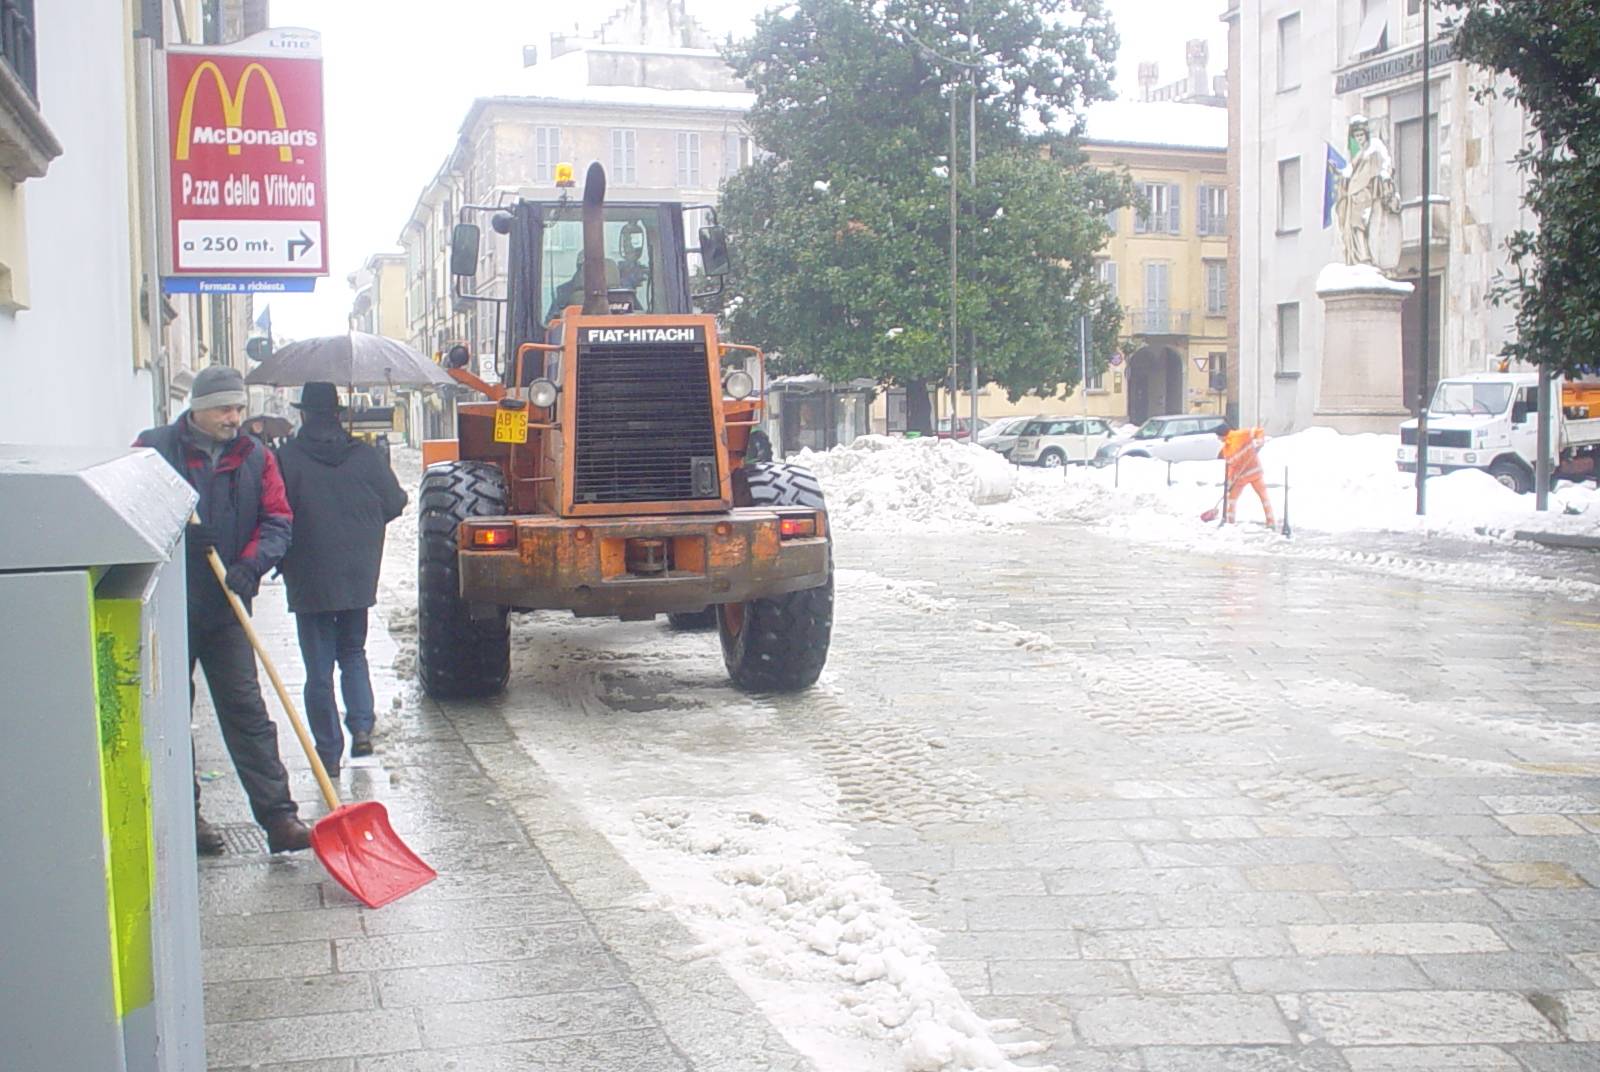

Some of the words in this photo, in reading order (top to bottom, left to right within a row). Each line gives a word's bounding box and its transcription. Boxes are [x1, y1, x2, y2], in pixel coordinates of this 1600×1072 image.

[193, 126, 317, 146] McDonald's
[182, 172, 219, 206] P.zza
[224, 173, 260, 206] della
[264, 173, 315, 207] Vittoria
[183, 240, 195, 252] a
[202, 237, 238, 252] 250
[245, 239, 274, 252] mt.
[200, 281, 237, 291] Fermata
[238, 282, 246, 291] a
[248, 281, 285, 291] richiesta
[588, 328, 695, 342] FIAT-HITACHI
[496, 427, 526, 441] 619
